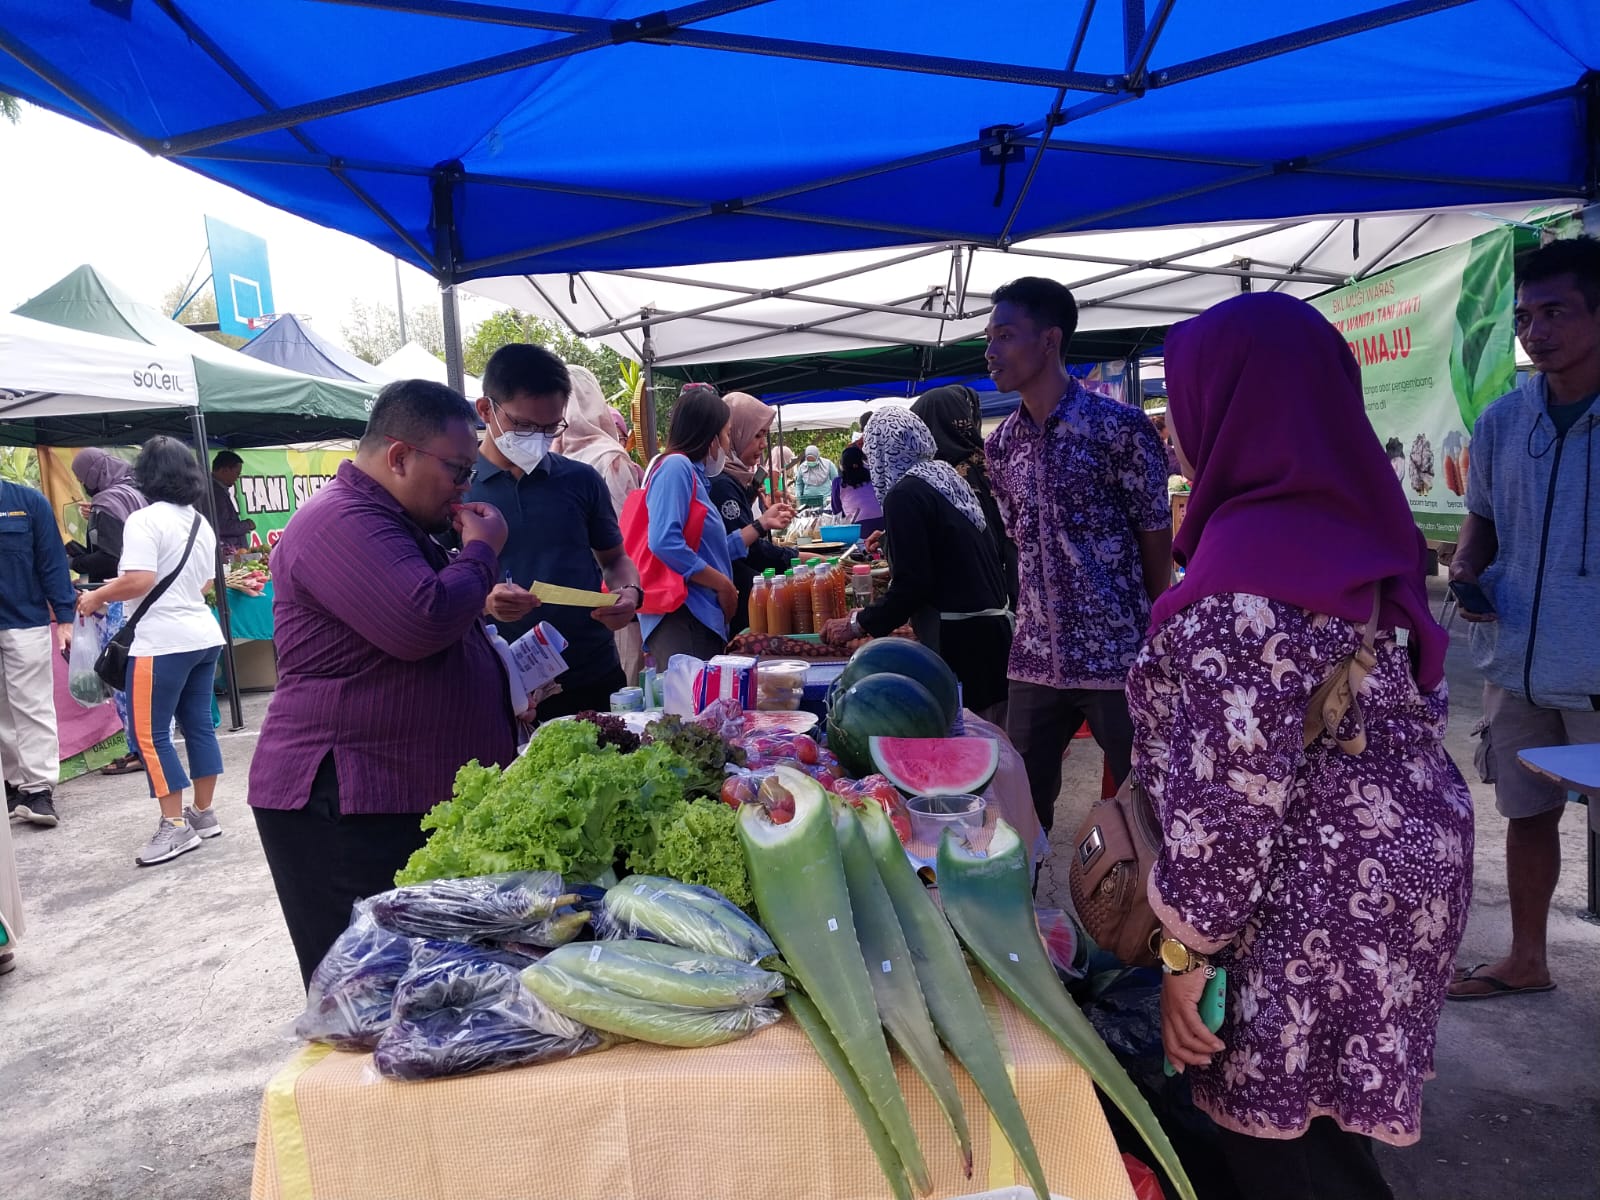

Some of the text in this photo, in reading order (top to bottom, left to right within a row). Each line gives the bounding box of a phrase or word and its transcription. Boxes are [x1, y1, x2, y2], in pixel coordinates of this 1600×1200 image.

[1346, 291, 1365, 308] MUGI
[1366, 280, 1395, 302] WARAS
[1347, 311, 1375, 332] WANITA
[1377, 304, 1395, 322] TANI
[1362, 326, 1412, 366] MAJU
[240, 475, 290, 514] TANI
